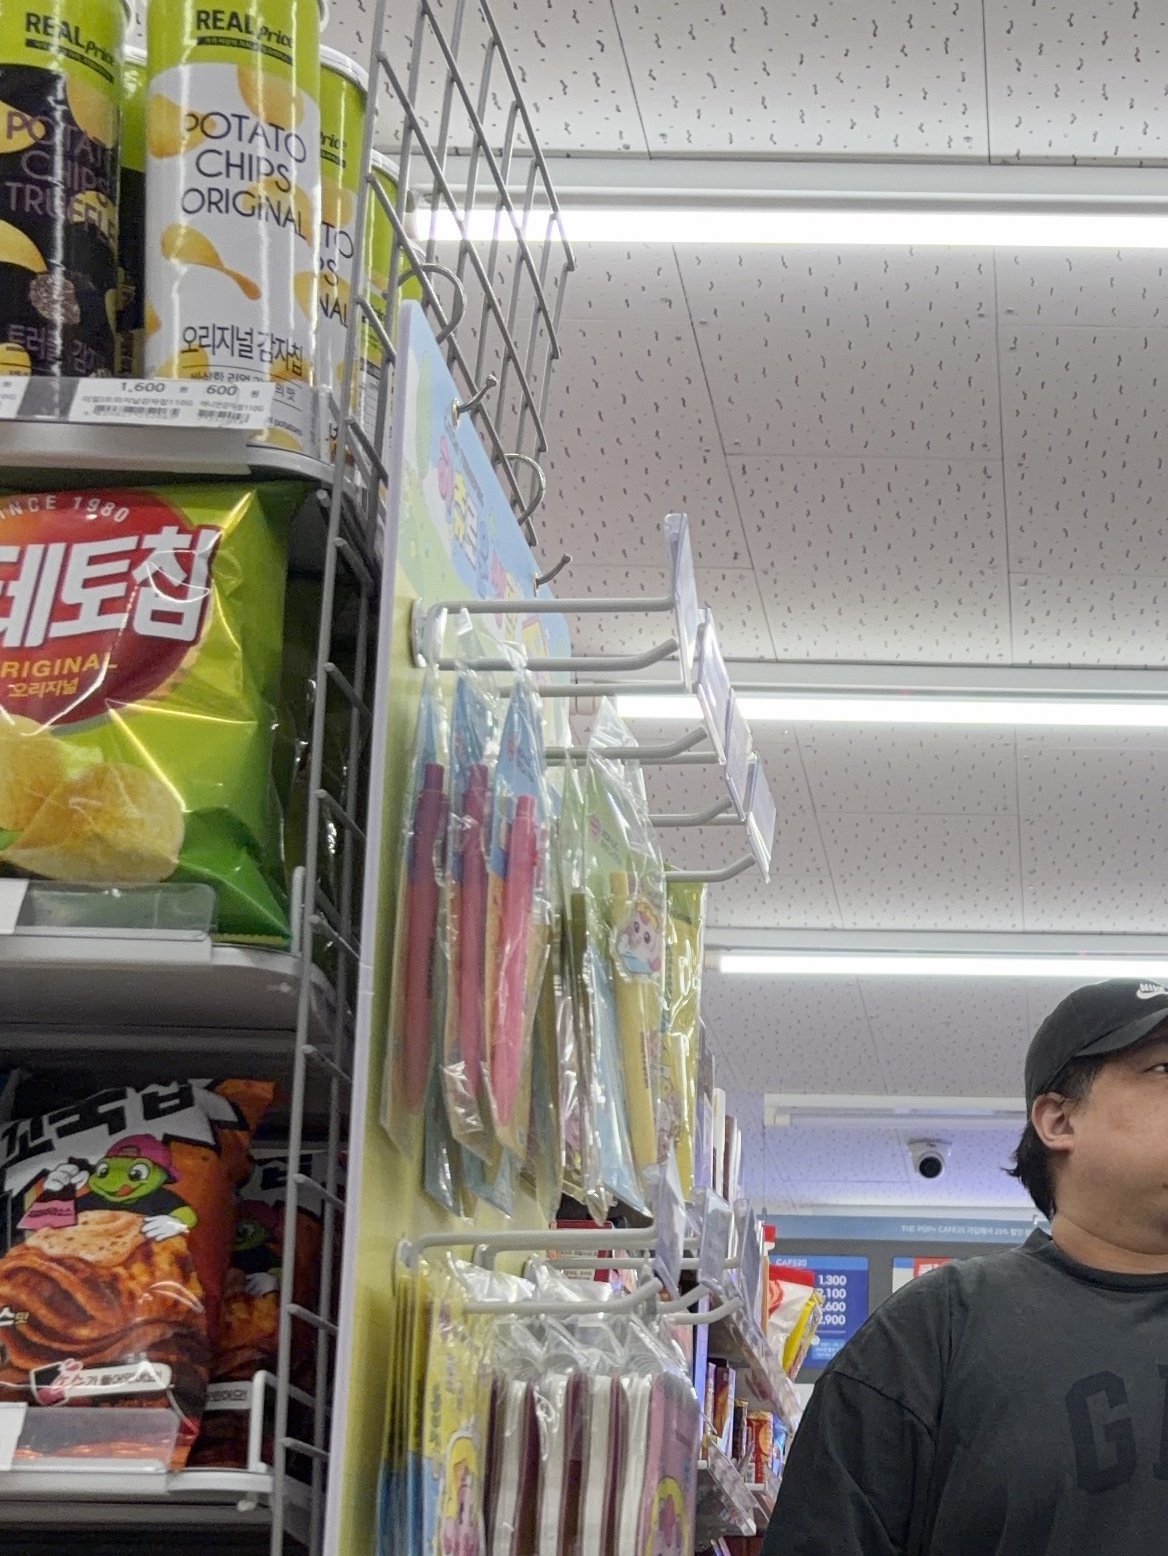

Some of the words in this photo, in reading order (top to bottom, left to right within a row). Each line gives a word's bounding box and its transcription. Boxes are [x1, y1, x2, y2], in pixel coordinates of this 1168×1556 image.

[25, 12, 84, 48] REAL
[197, 10, 254, 35] REAL
[184, 111, 307, 163] POTATO
[195, 149, 291, 193] CHIPS
[181, 187, 308, 241] ORIGINAL
[180, 323, 254, 360] 오리지널
[257, 330, 304, 377] 감자칩
[206, 384, 237, 396] 600
[73, 495, 131, 524] 1980
[0, 525, 224, 651] 테토칩
[0, 652, 118, 677] RIGINAL
[8, 676, 79, 699] 오리지널
